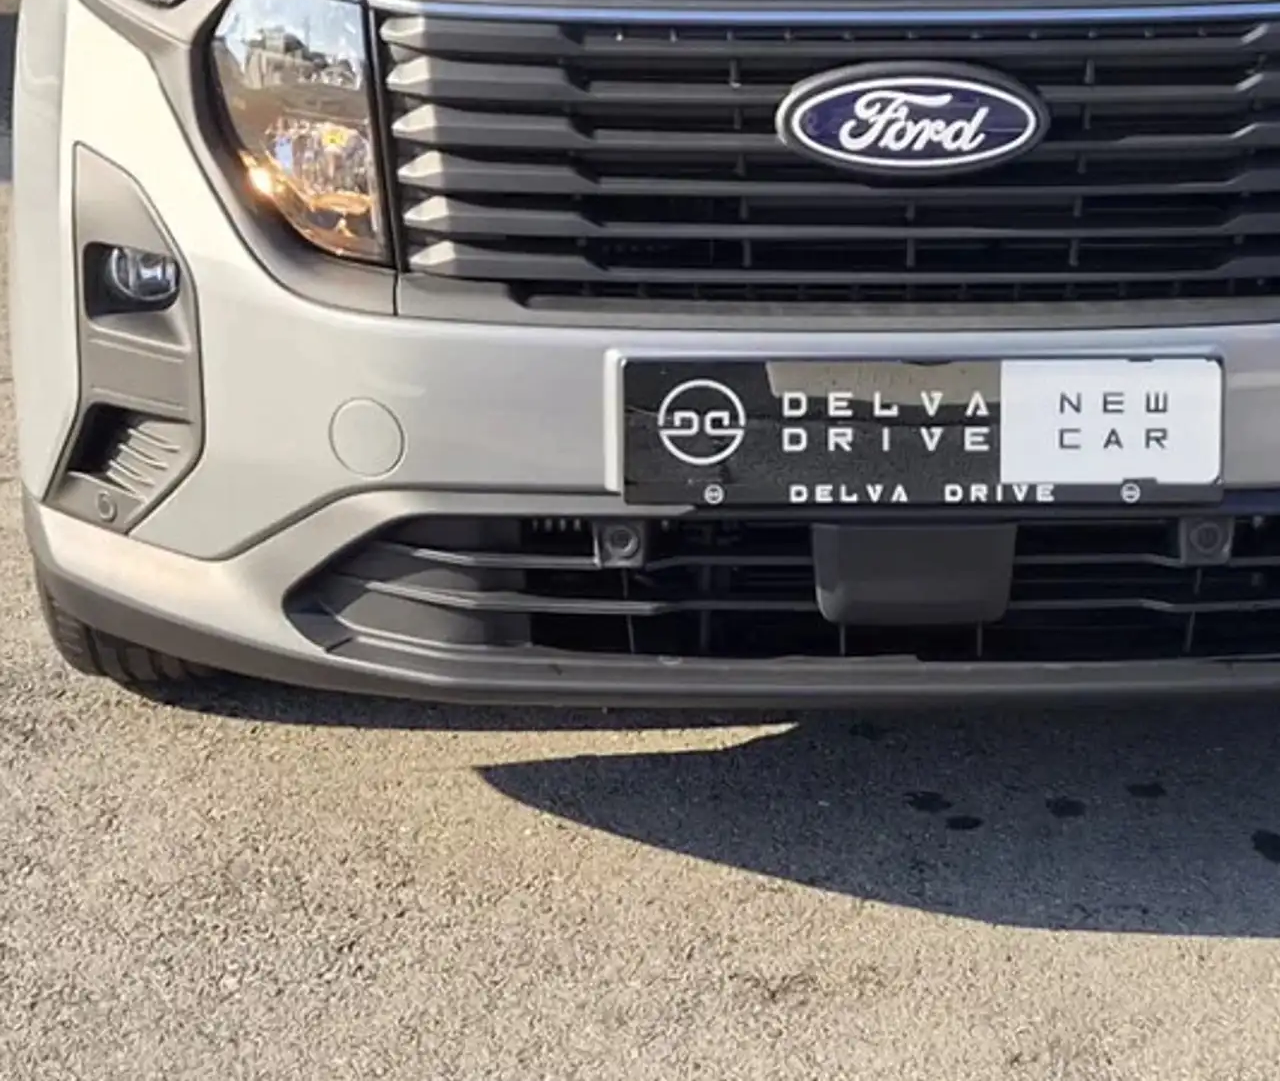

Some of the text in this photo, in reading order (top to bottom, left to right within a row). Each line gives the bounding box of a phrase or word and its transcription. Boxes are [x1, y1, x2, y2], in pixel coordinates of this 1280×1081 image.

[838, 90, 989, 151] Ford
[781, 391, 990, 417] DELVA
[1058, 392, 1170, 415] NEW
[781, 426, 991, 452] DRIVE
[1058, 427, 1169, 450] CAR
[788, 483, 1056, 503] DELVA DRIVE
